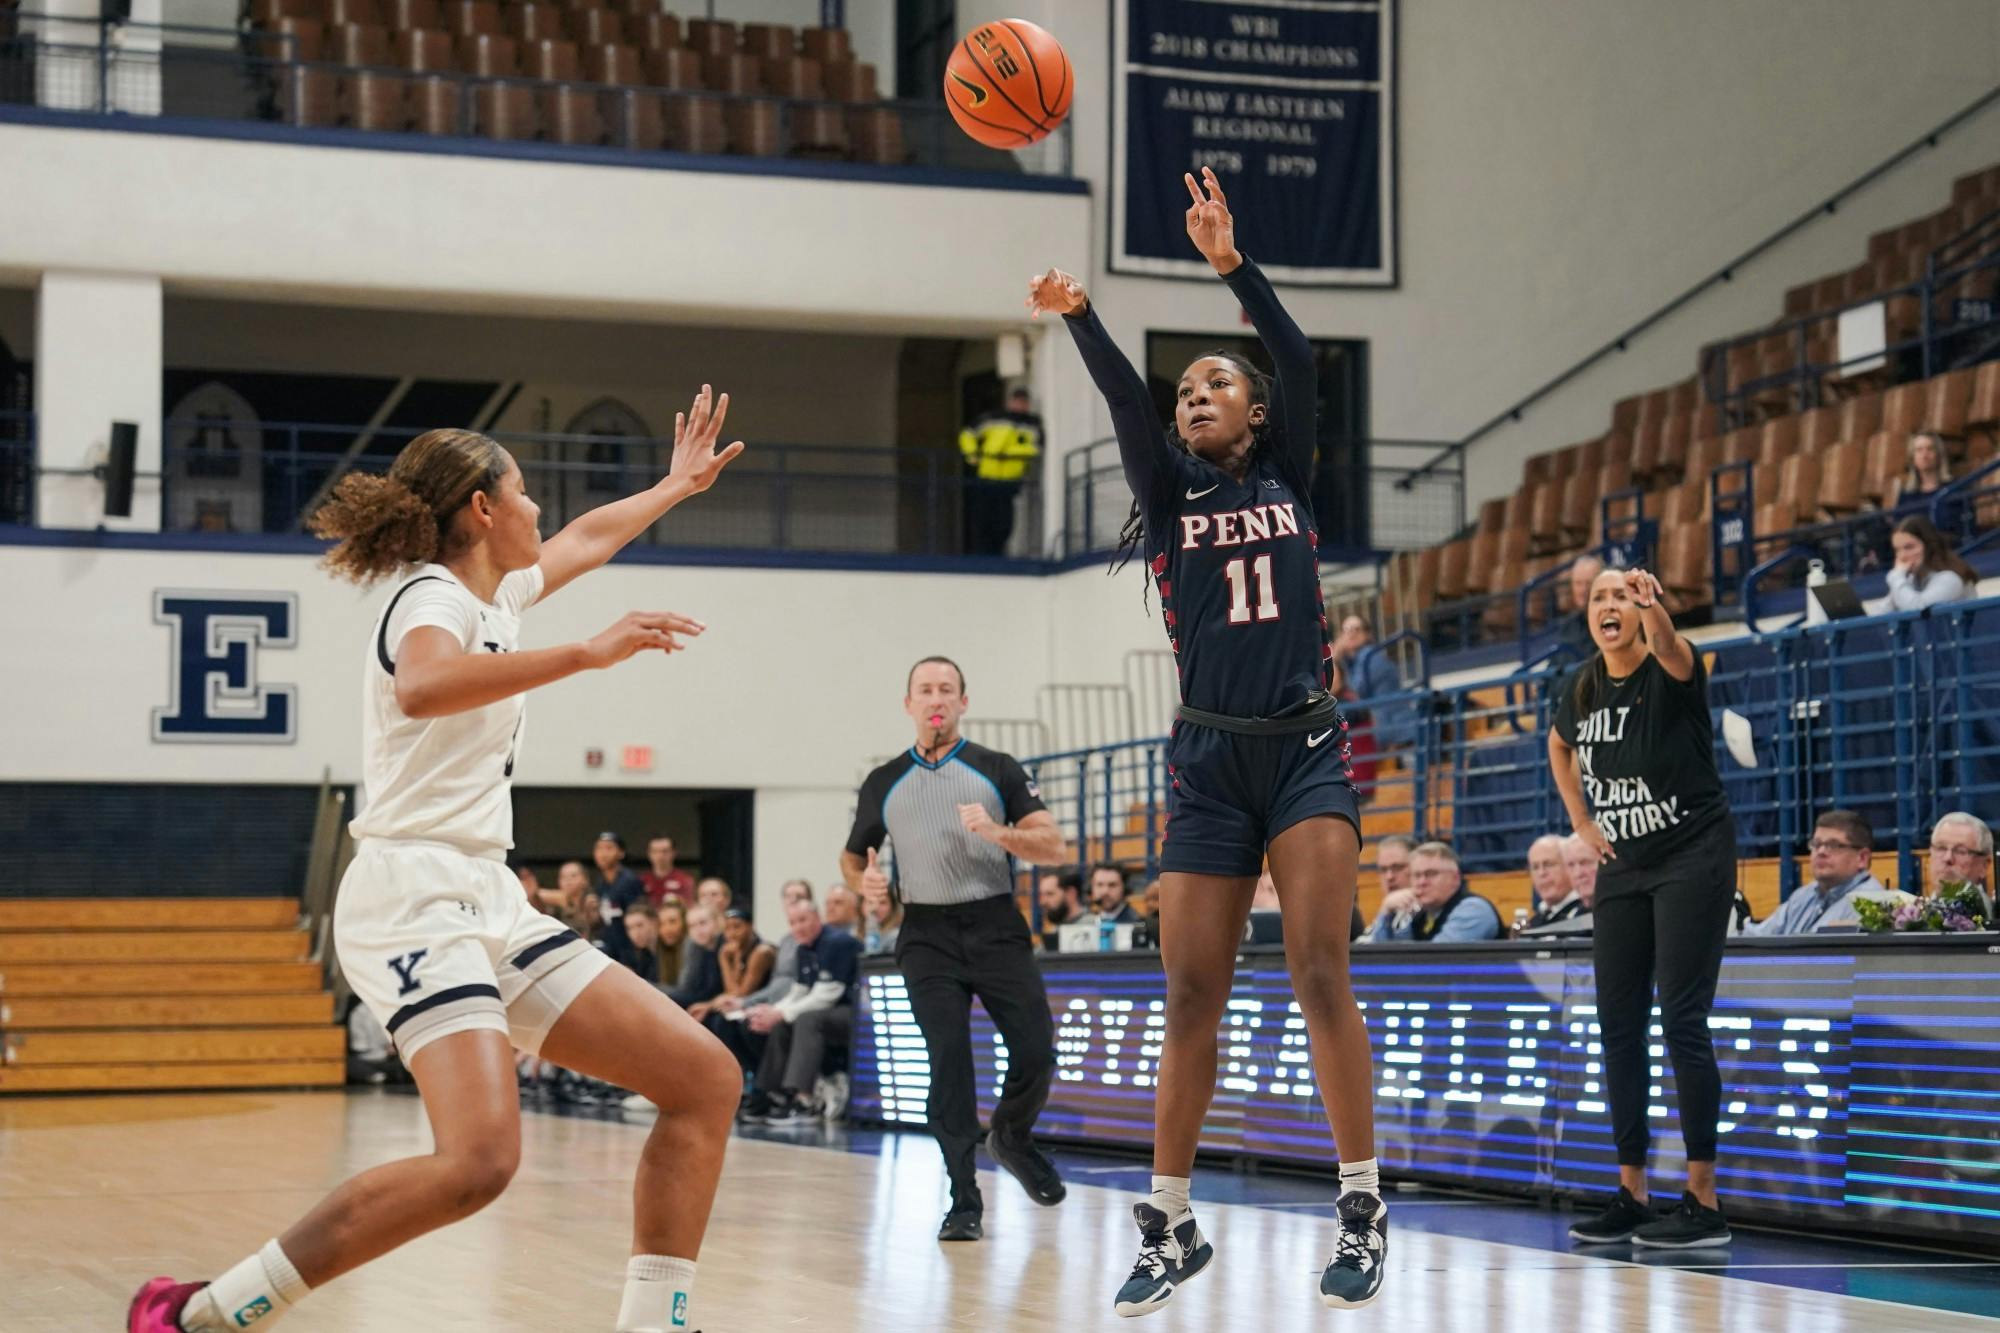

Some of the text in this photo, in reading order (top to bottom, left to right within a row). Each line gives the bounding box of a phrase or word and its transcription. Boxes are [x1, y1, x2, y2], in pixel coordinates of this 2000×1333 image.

[1229, 14, 1280, 38] WBI
[1150, 32, 1359, 67] 2018 CHAMPIONS
[1235, 92, 1345, 120] EASTERN
[1192, 115, 1317, 146] REGIONAL
[1191, 150, 1318, 178] 1978 1979
[1179, 502, 1300, 551] PENN
[1223, 552, 1281, 624] 11
[152, 588, 299, 745] E
[1578, 745, 1595, 776] N
[1595, 795, 1690, 843] STORY.
[386, 946, 428, 998] Y
